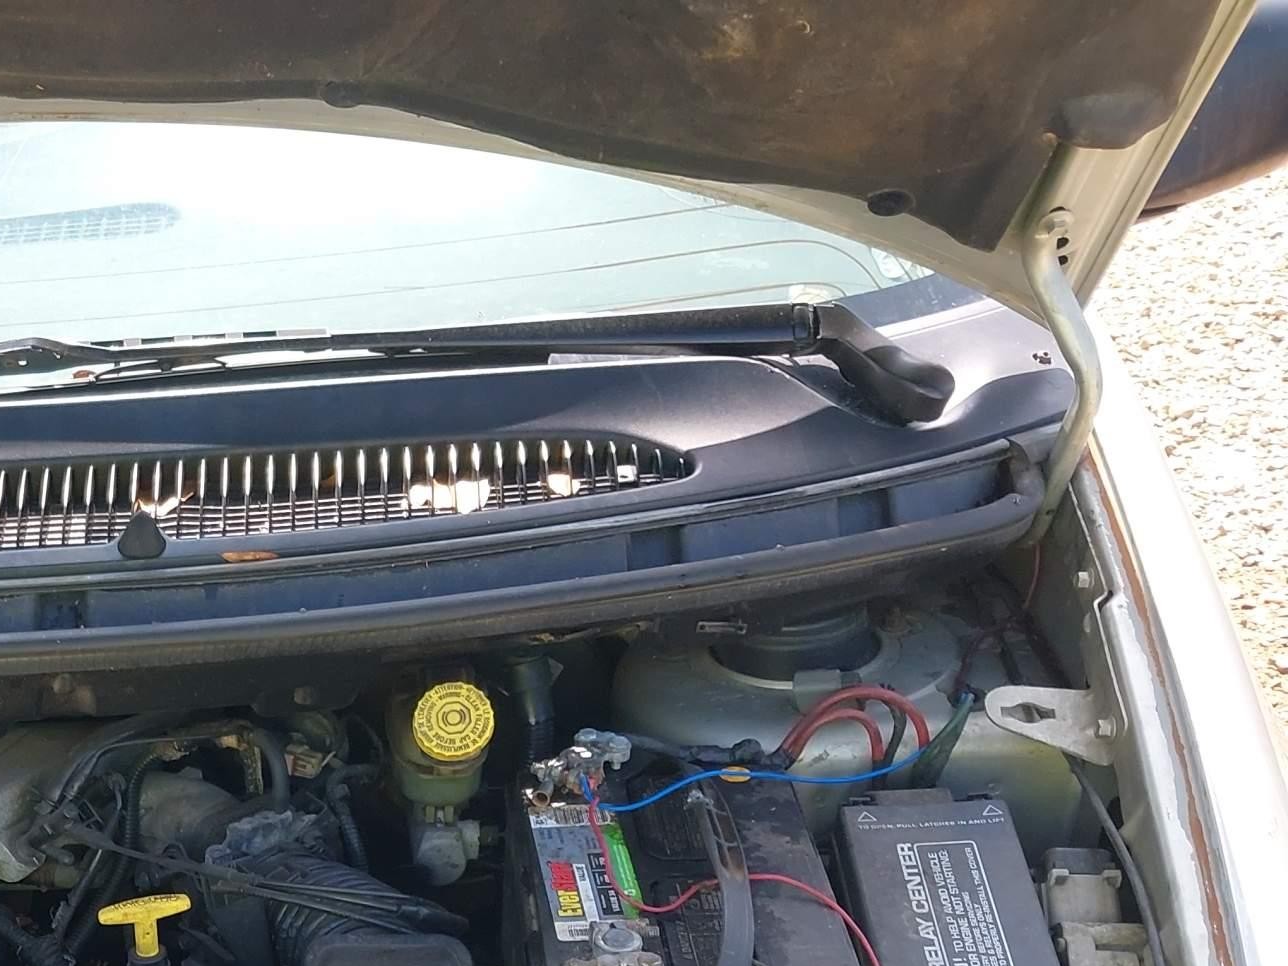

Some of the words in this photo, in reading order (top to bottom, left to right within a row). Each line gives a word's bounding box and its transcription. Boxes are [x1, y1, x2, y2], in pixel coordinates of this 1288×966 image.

[460, 734, 471, 742] CAP
[928, 853, 945, 887] VEHICLE
[965, 849, 977, 869] COVER
[897, 843, 930, 914] CENTER
[972, 871, 982, 885] THIS
[938, 889, 953, 913] AVOID
[951, 896, 966, 914] NOT
[962, 893, 978, 926] SERVICING
[974, 904, 985, 921] ONLY
[946, 917, 961, 938] HELP
[957, 917, 977, 952] ENGINE
[979, 923, 993, 948] RELAYS
[953, 940, 964, 953] TO
[972, 928, 986, 953] BEFORE
[988, 925, 1005, 959] PROPERLY
